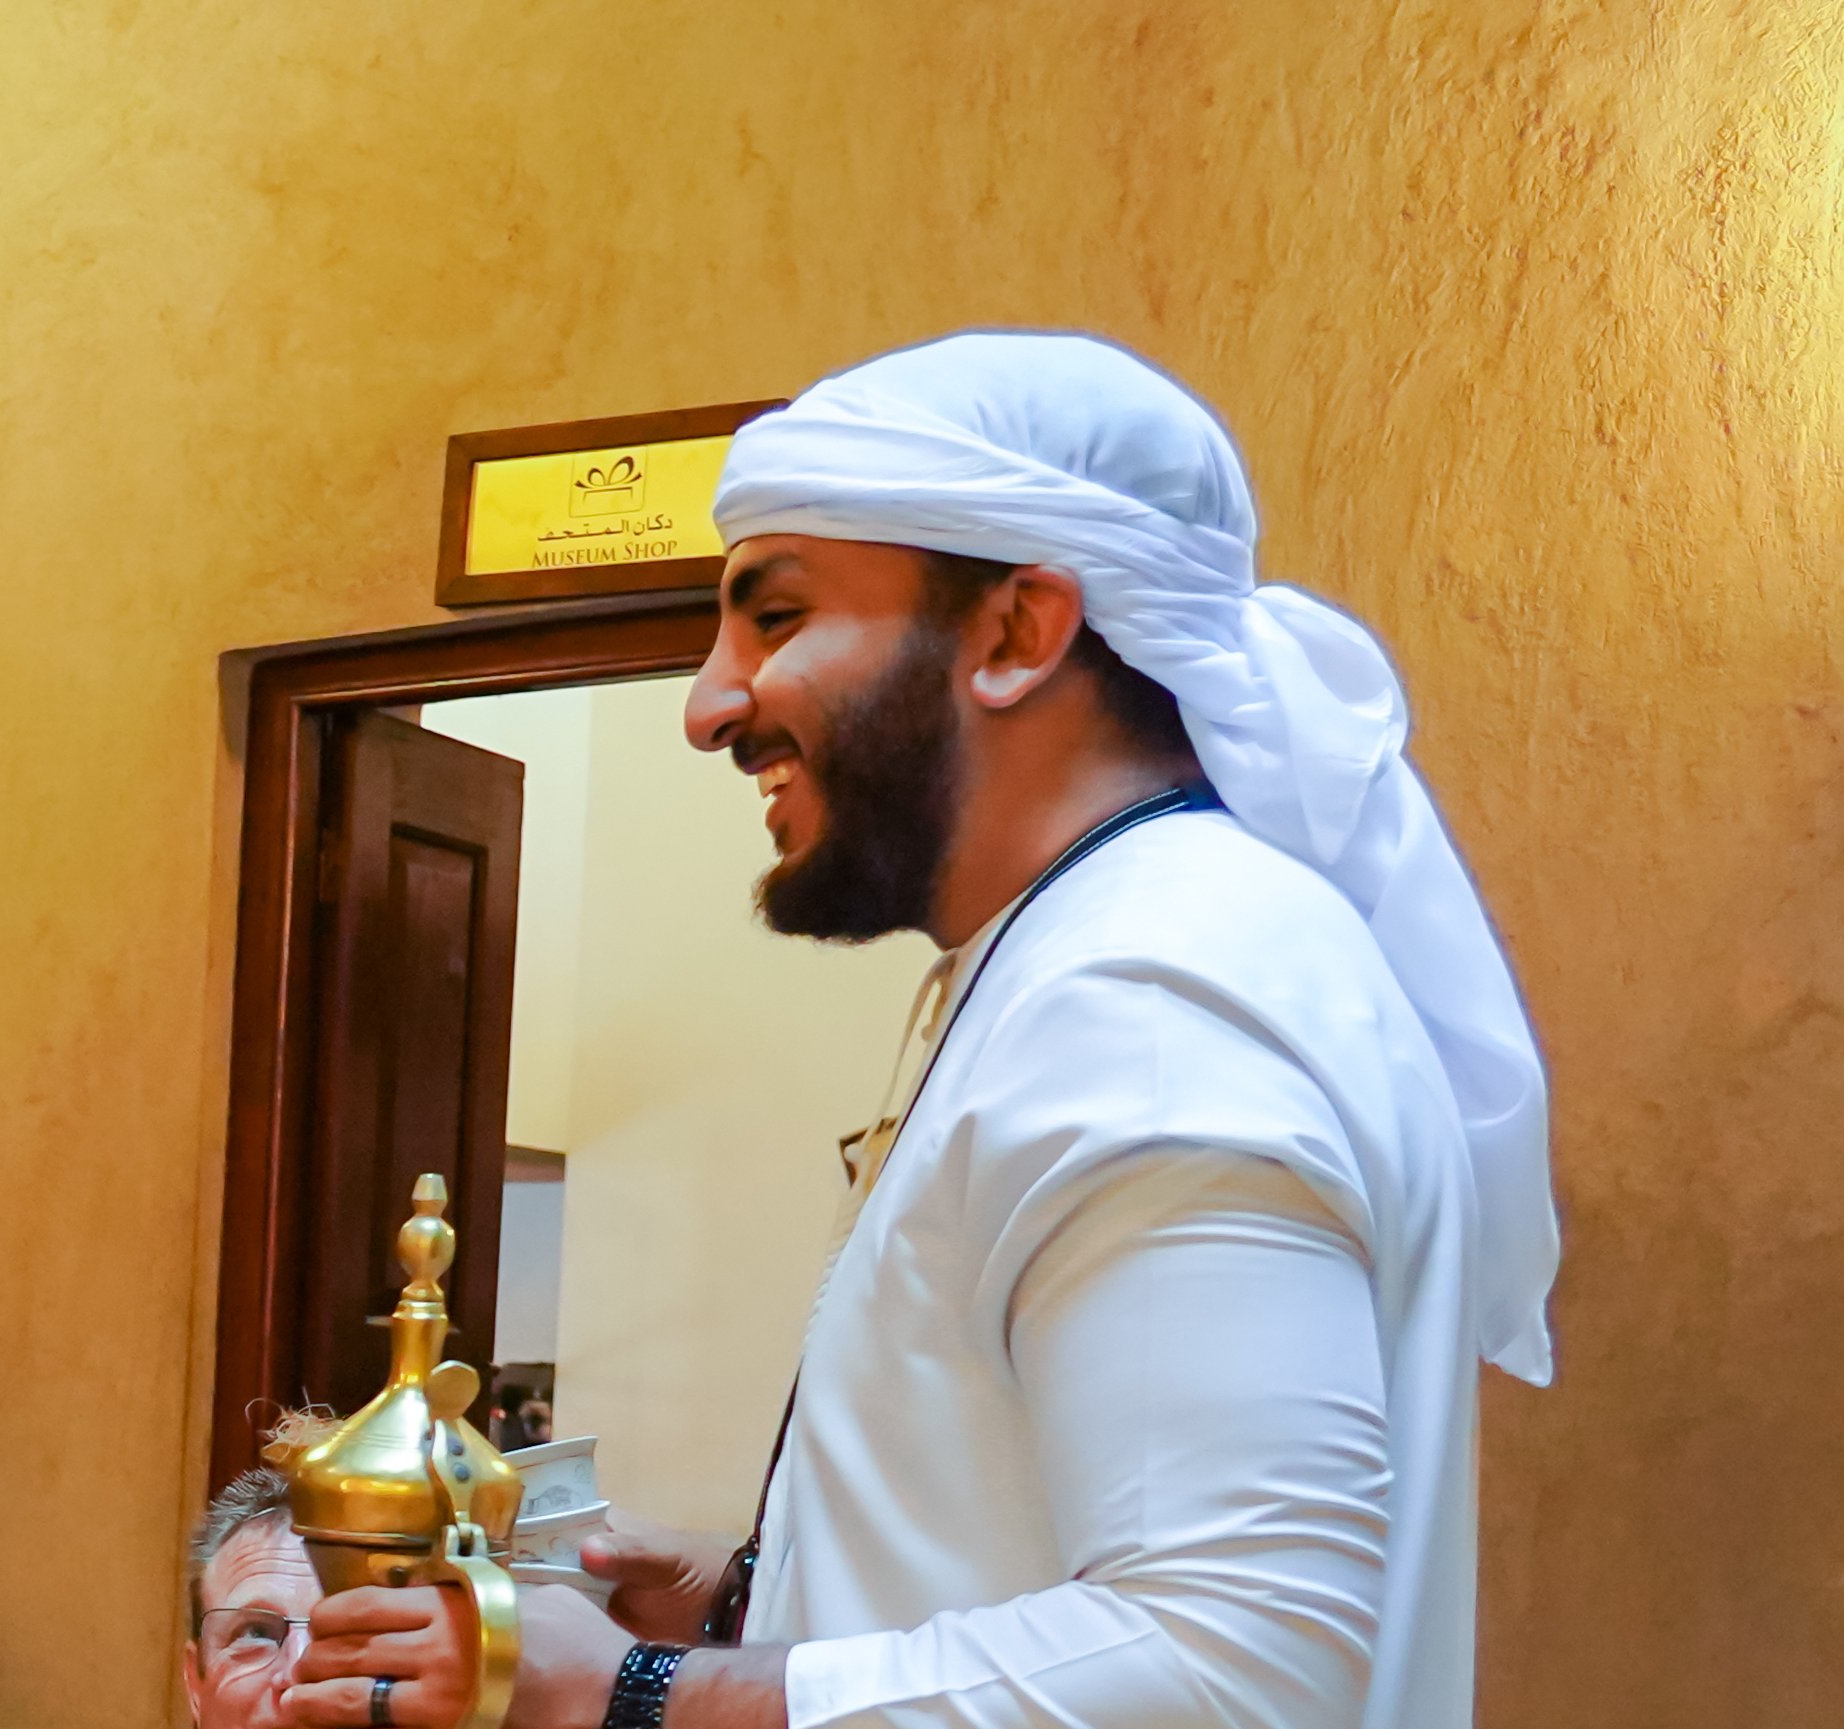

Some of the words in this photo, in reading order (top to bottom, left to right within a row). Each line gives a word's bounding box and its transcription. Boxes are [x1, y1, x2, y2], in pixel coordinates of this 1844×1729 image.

[633, 513, 674, 536] دكان
[531, 547, 617, 568] MUSEUM
[623, 540, 678, 561] SHOP
